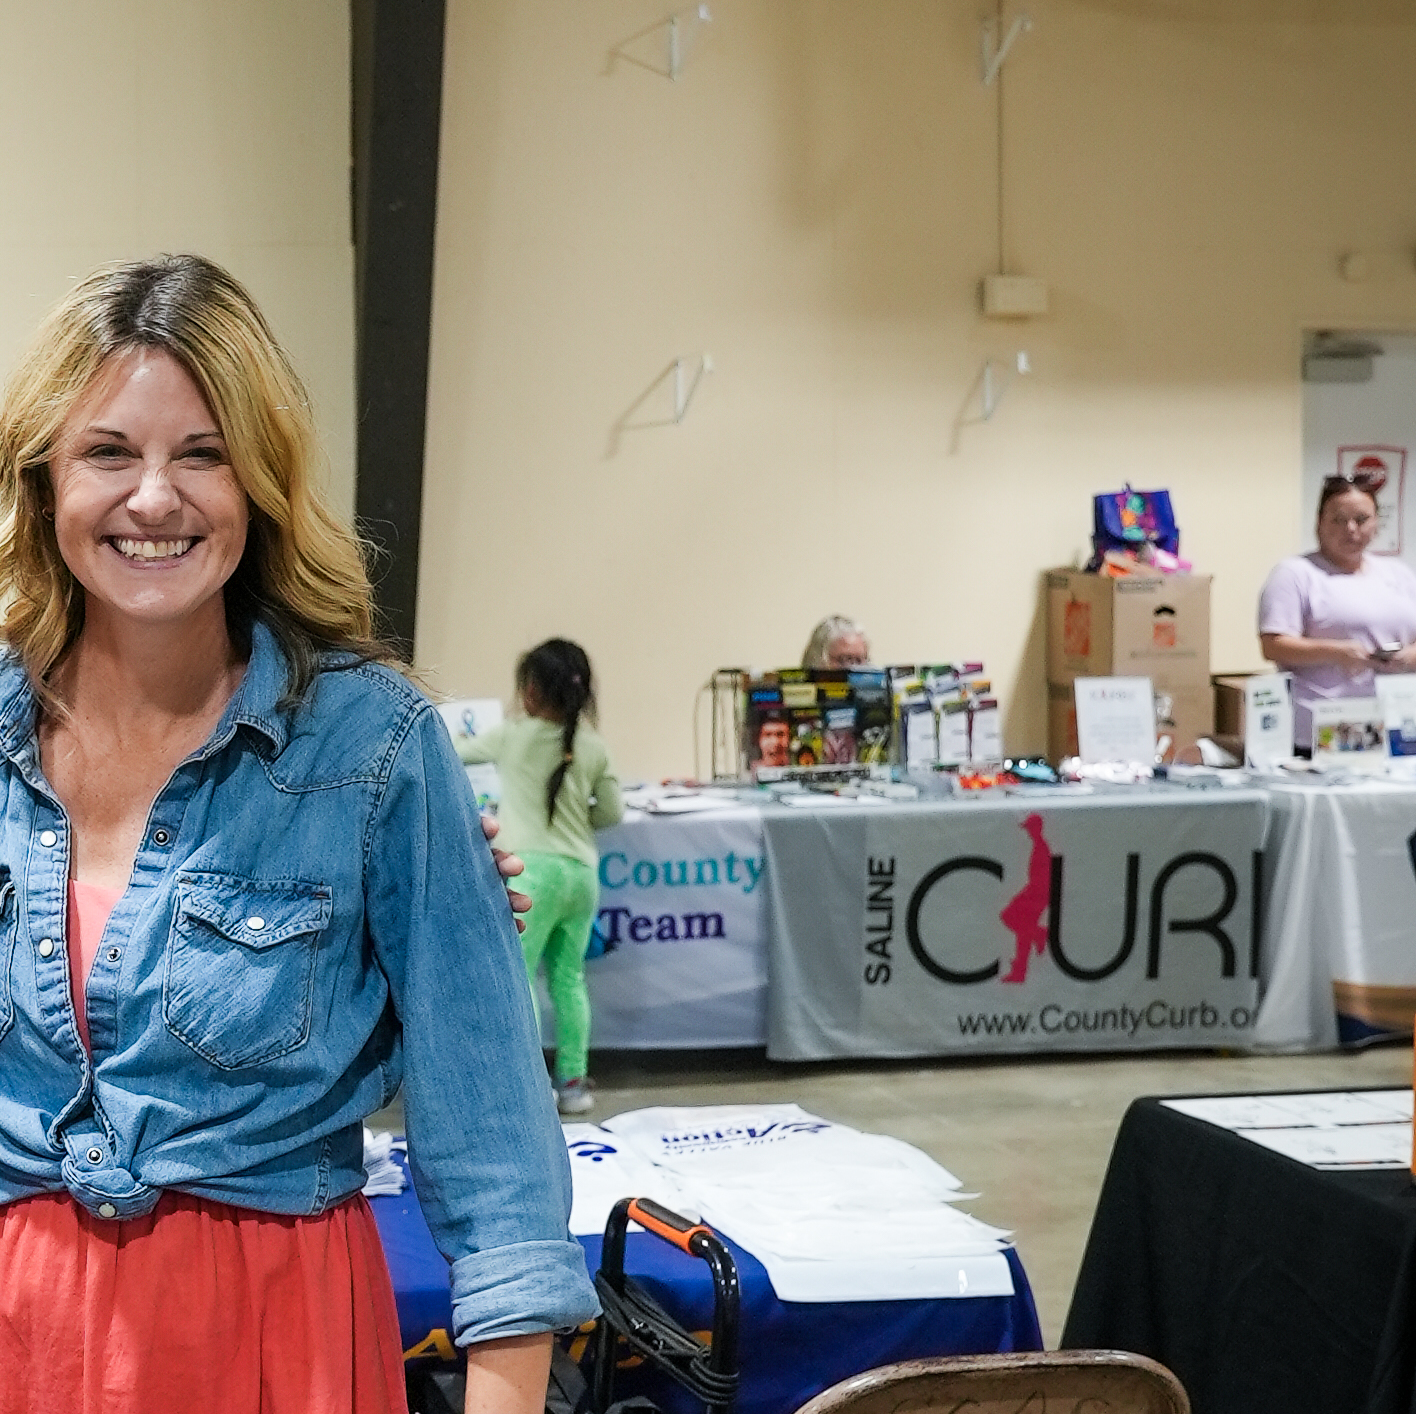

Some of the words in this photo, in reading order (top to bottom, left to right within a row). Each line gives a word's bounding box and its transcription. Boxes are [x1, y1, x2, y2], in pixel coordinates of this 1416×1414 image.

[598, 851, 765, 893] County
[598, 907, 726, 943] Team
[864, 855, 896, 985] SALINE
